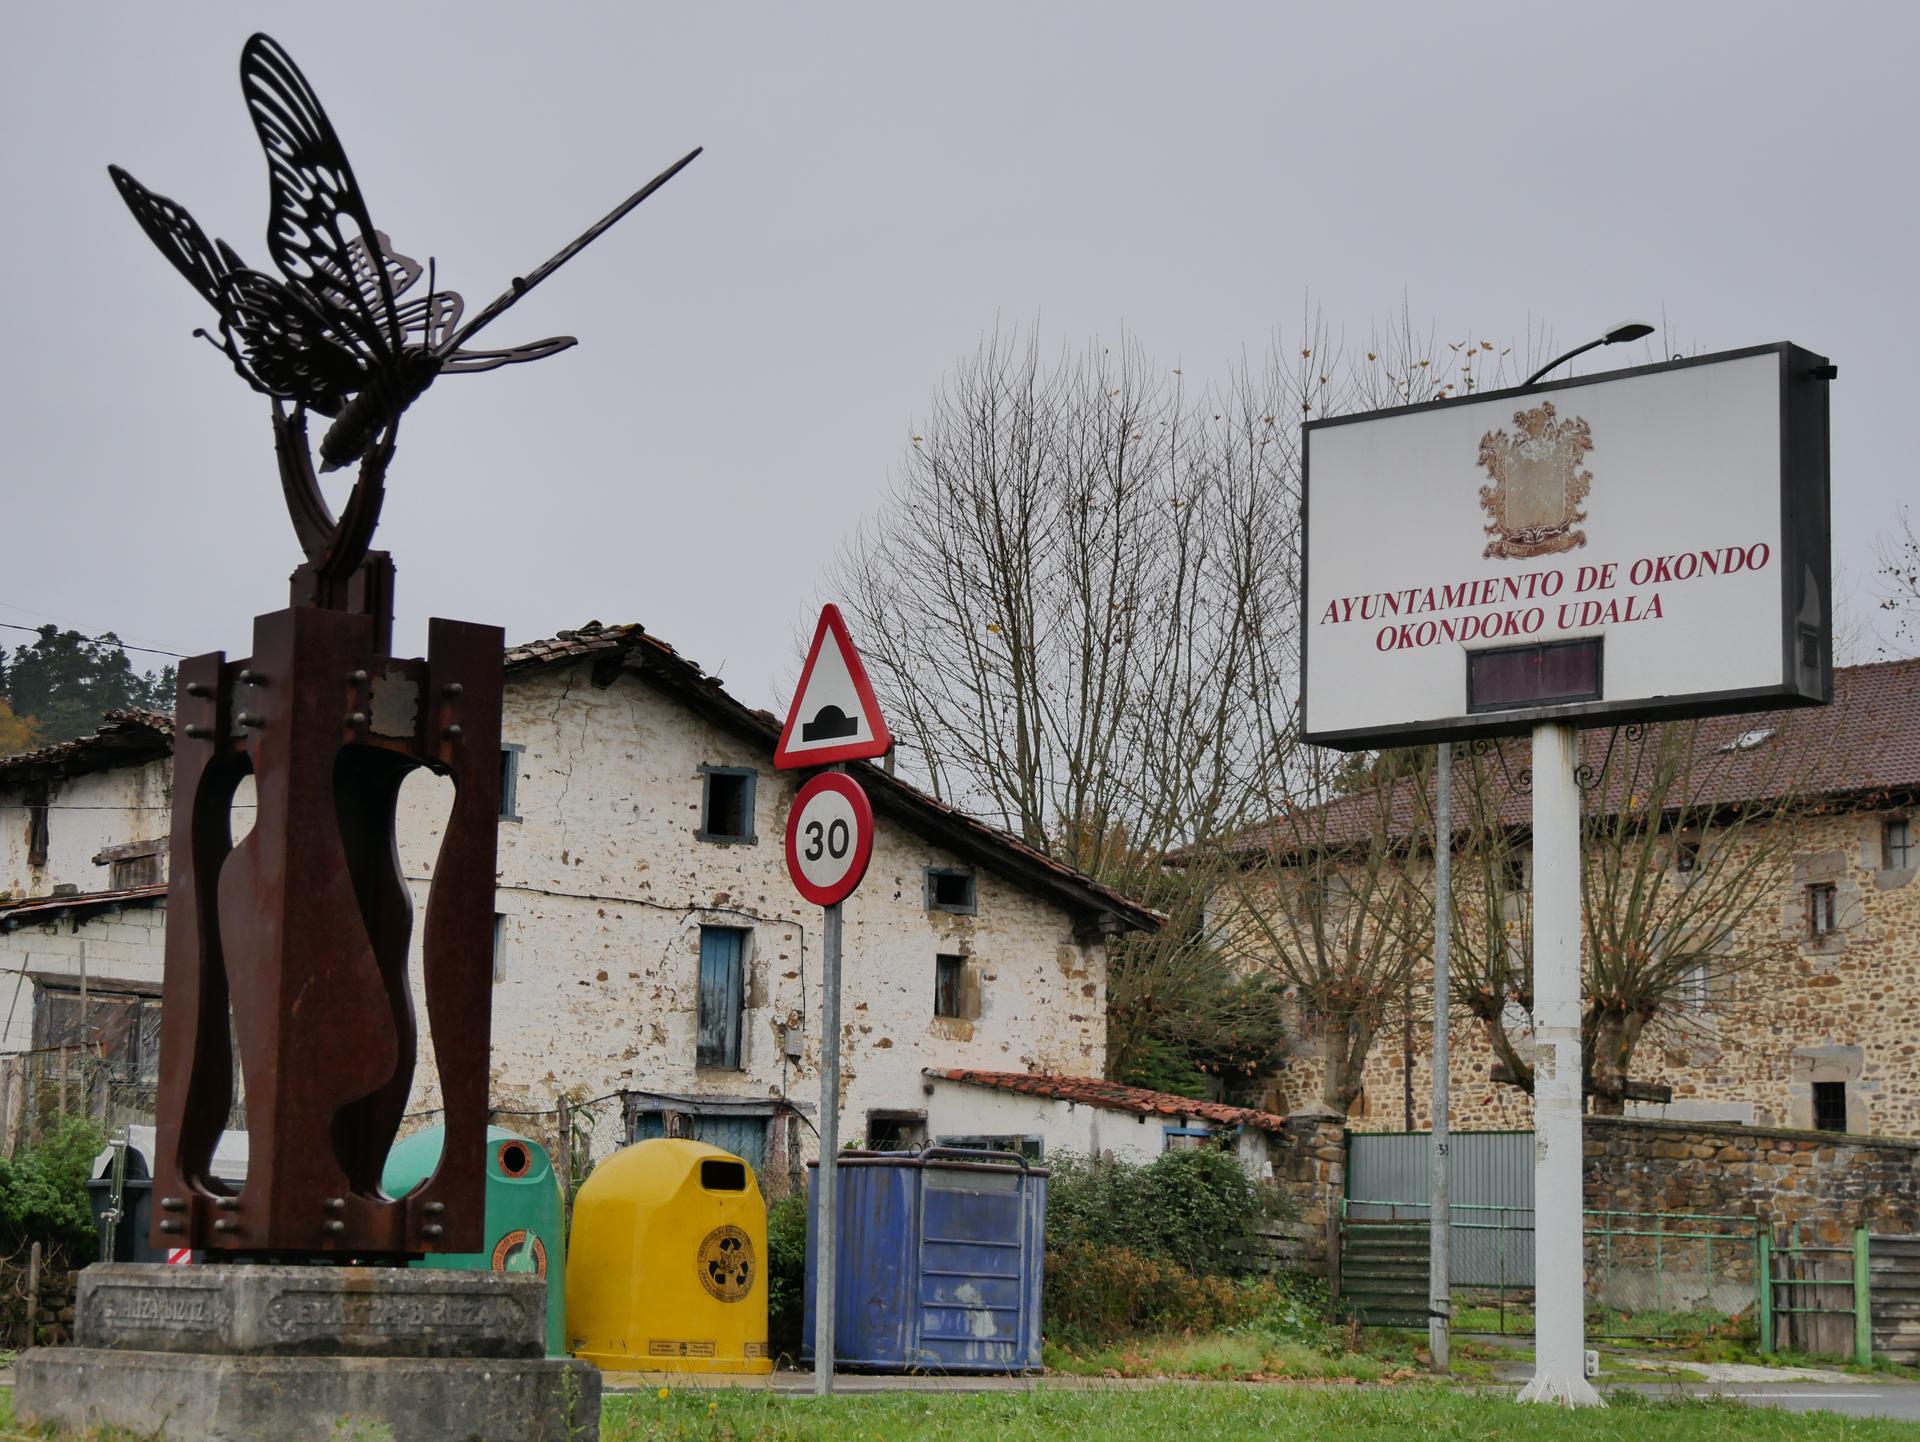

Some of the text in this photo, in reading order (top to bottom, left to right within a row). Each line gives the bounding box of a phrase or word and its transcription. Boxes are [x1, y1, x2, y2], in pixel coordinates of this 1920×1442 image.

[1321, 543, 1770, 625] AYUNTAMIENTO DE OKONDO
[1376, 593, 1664, 651] OKONDOKO UDALA
[804, 818, 850, 861] 30
